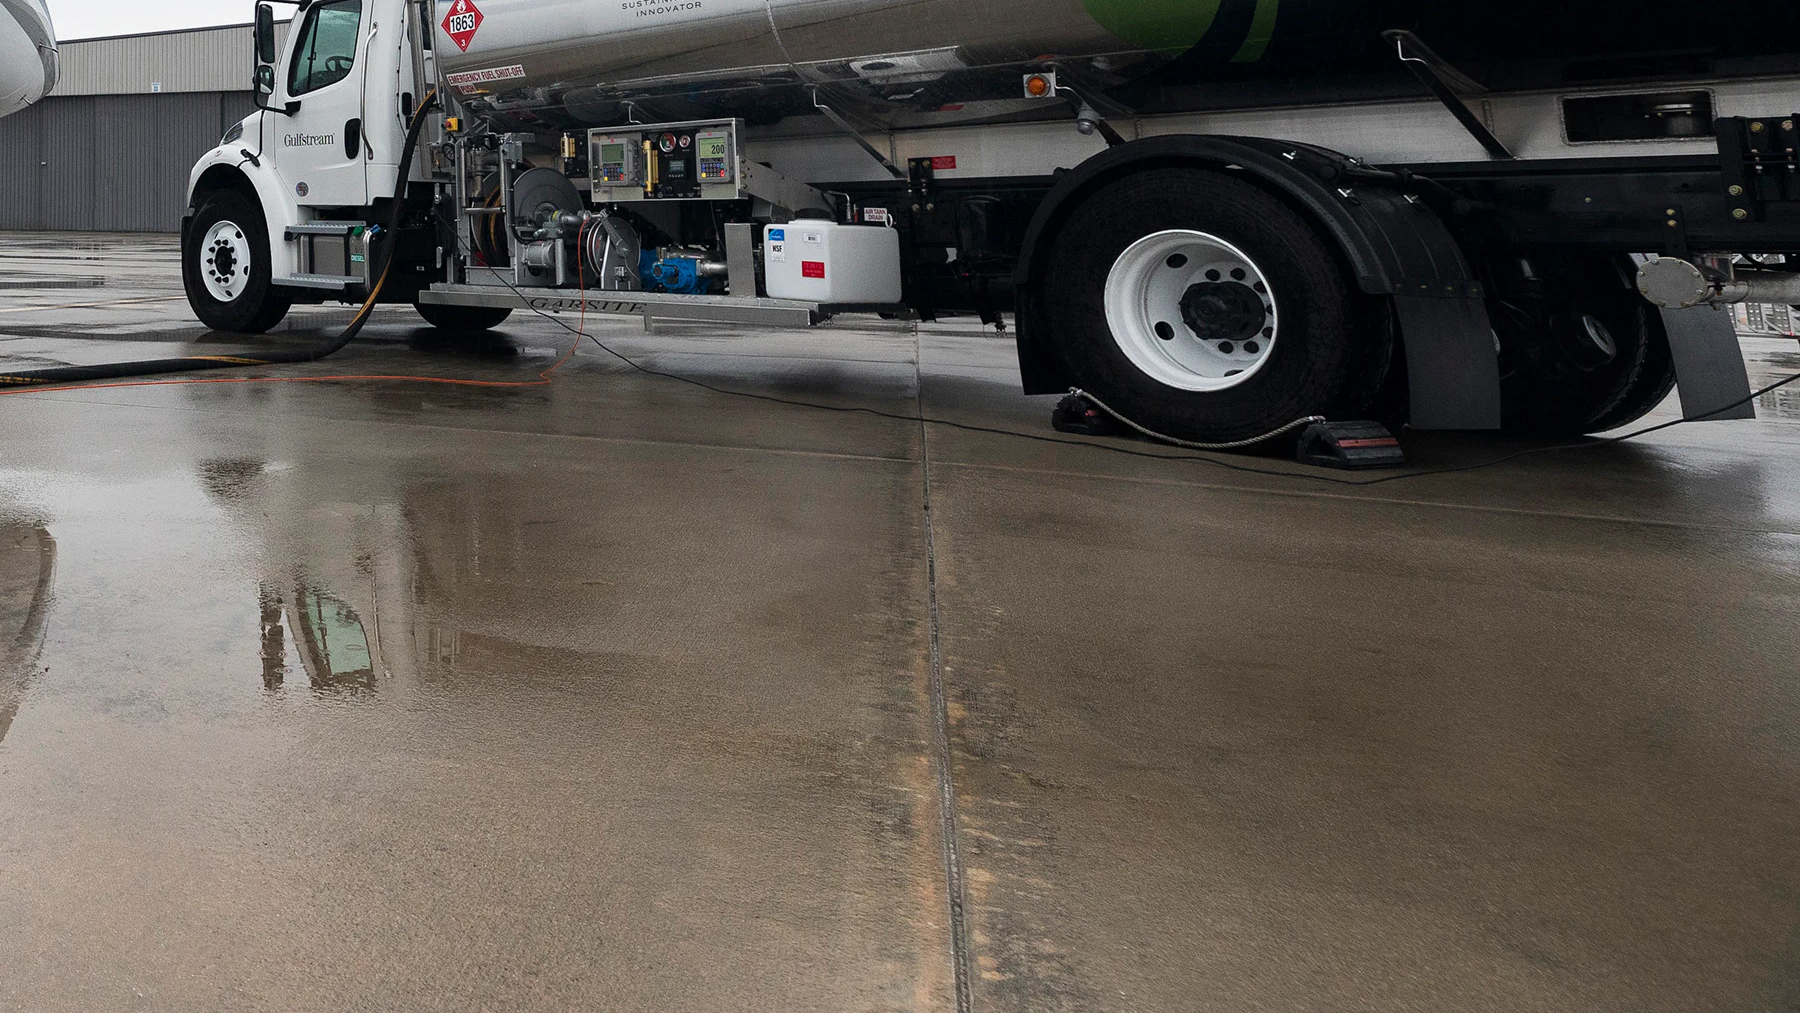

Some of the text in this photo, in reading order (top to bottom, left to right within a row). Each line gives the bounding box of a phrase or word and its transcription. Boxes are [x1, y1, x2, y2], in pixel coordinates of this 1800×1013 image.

[636, 1, 702, 17] INNOVATOR
[450, 14, 474, 32] 1863
[461, 38, 466, 47] 3
[448, 66, 523, 85] EMERGENCY FUEL SHUT-OFF
[284, 133, 335, 147] Gulfstream
[711, 144, 725, 154] 200
[772, 244, 783, 253] NSF
[530, 297, 647, 313] GARSITE
